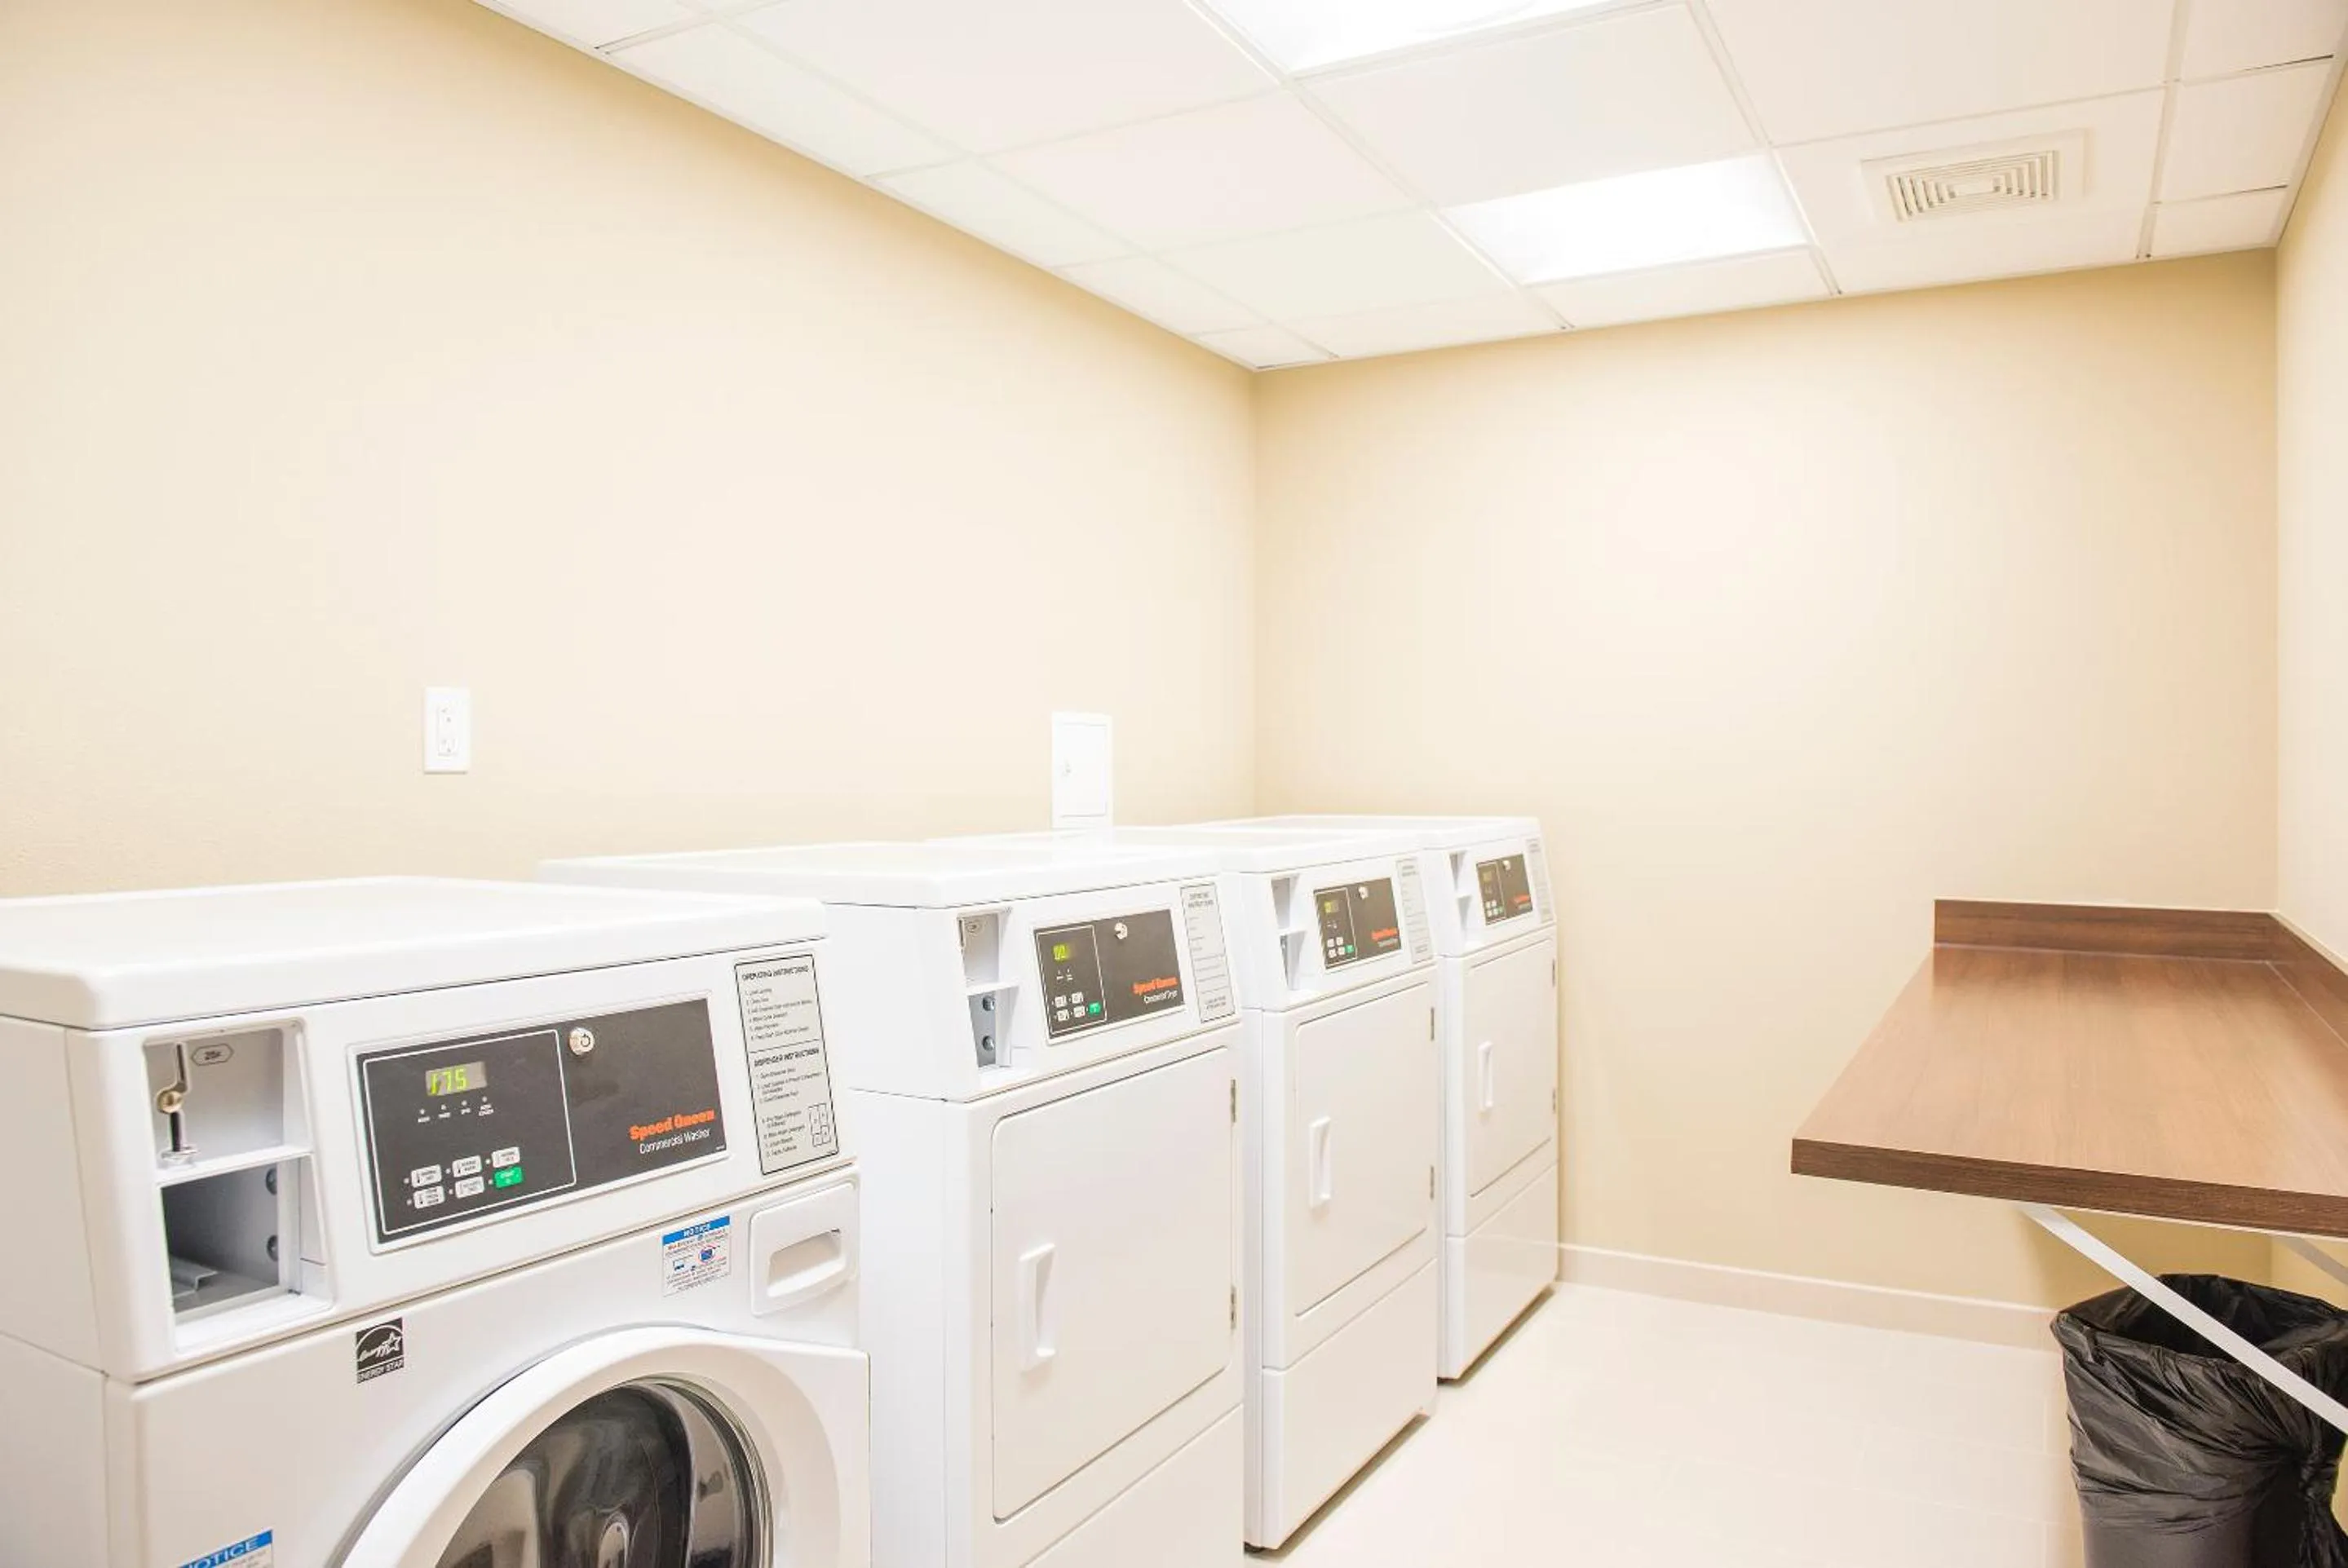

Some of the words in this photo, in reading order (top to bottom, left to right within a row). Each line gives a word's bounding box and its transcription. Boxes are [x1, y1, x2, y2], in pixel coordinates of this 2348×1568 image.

[629, 1116, 673, 1141] Speed
[674, 1108, 715, 1129] Queen
[639, 1133, 683, 1155] Commercial
[683, 1128, 711, 1143] Washer
[188, 1538, 259, 1568] OTICE
